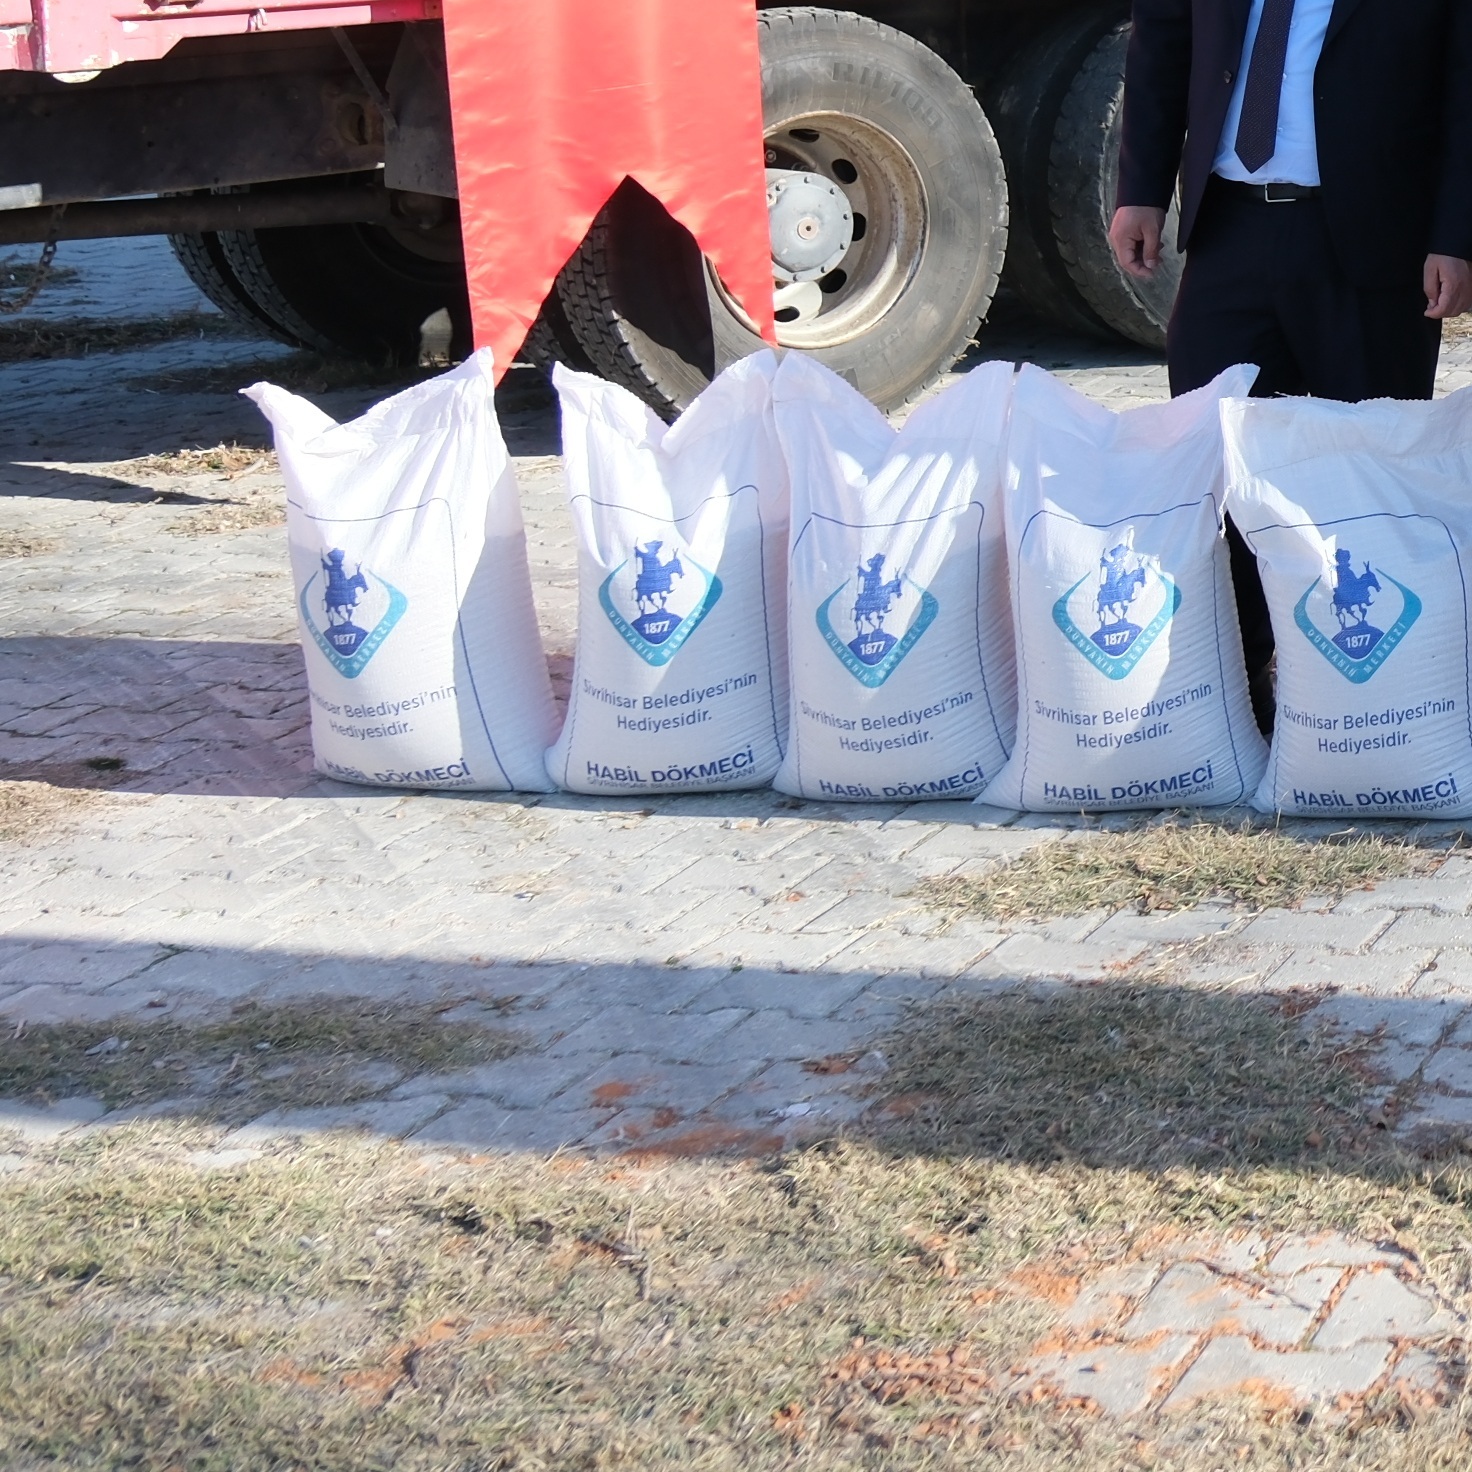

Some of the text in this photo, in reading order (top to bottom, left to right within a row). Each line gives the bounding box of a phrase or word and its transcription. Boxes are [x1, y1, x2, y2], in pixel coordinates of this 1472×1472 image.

[333, 633, 356, 646] 1877
[643, 620, 670, 635] 1877
[1104, 630, 1130, 646] 1877
[1345, 634, 1371, 648] 1877
[860, 641, 885, 656] 1877
[345, 686, 457, 718] Belediyesi'nin
[583, 673, 757, 710] Sivrihisar Belediyesi'nin
[1035, 683, 1212, 726] Sivrihisar Belediyesi'nin
[617, 708, 712, 733] Hediyesidir.
[801, 690, 973, 731] Sivrihisar Belediyesi'nin
[1283, 698, 1456, 730] Sivrihisar Belediyesi'nin
[329, 719, 413, 740] Hediyesidir.
[840, 730, 933, 753] Hediyesidir.
[1076, 721, 1172, 749] Hediyesidir.
[1318, 731, 1412, 754] Hediyesidir.
[375, 757, 471, 783] DÖKMECİ
[587, 761, 647, 783] HABİL
[651, 744, 754, 783] DÖKMECİ
[819, 762, 984, 797] HABİL DÖKMECİ
[1044, 760, 1213, 801] HABİL DÖKMECİ
[1293, 772, 1458, 806] HABİL DÖKMECİ
